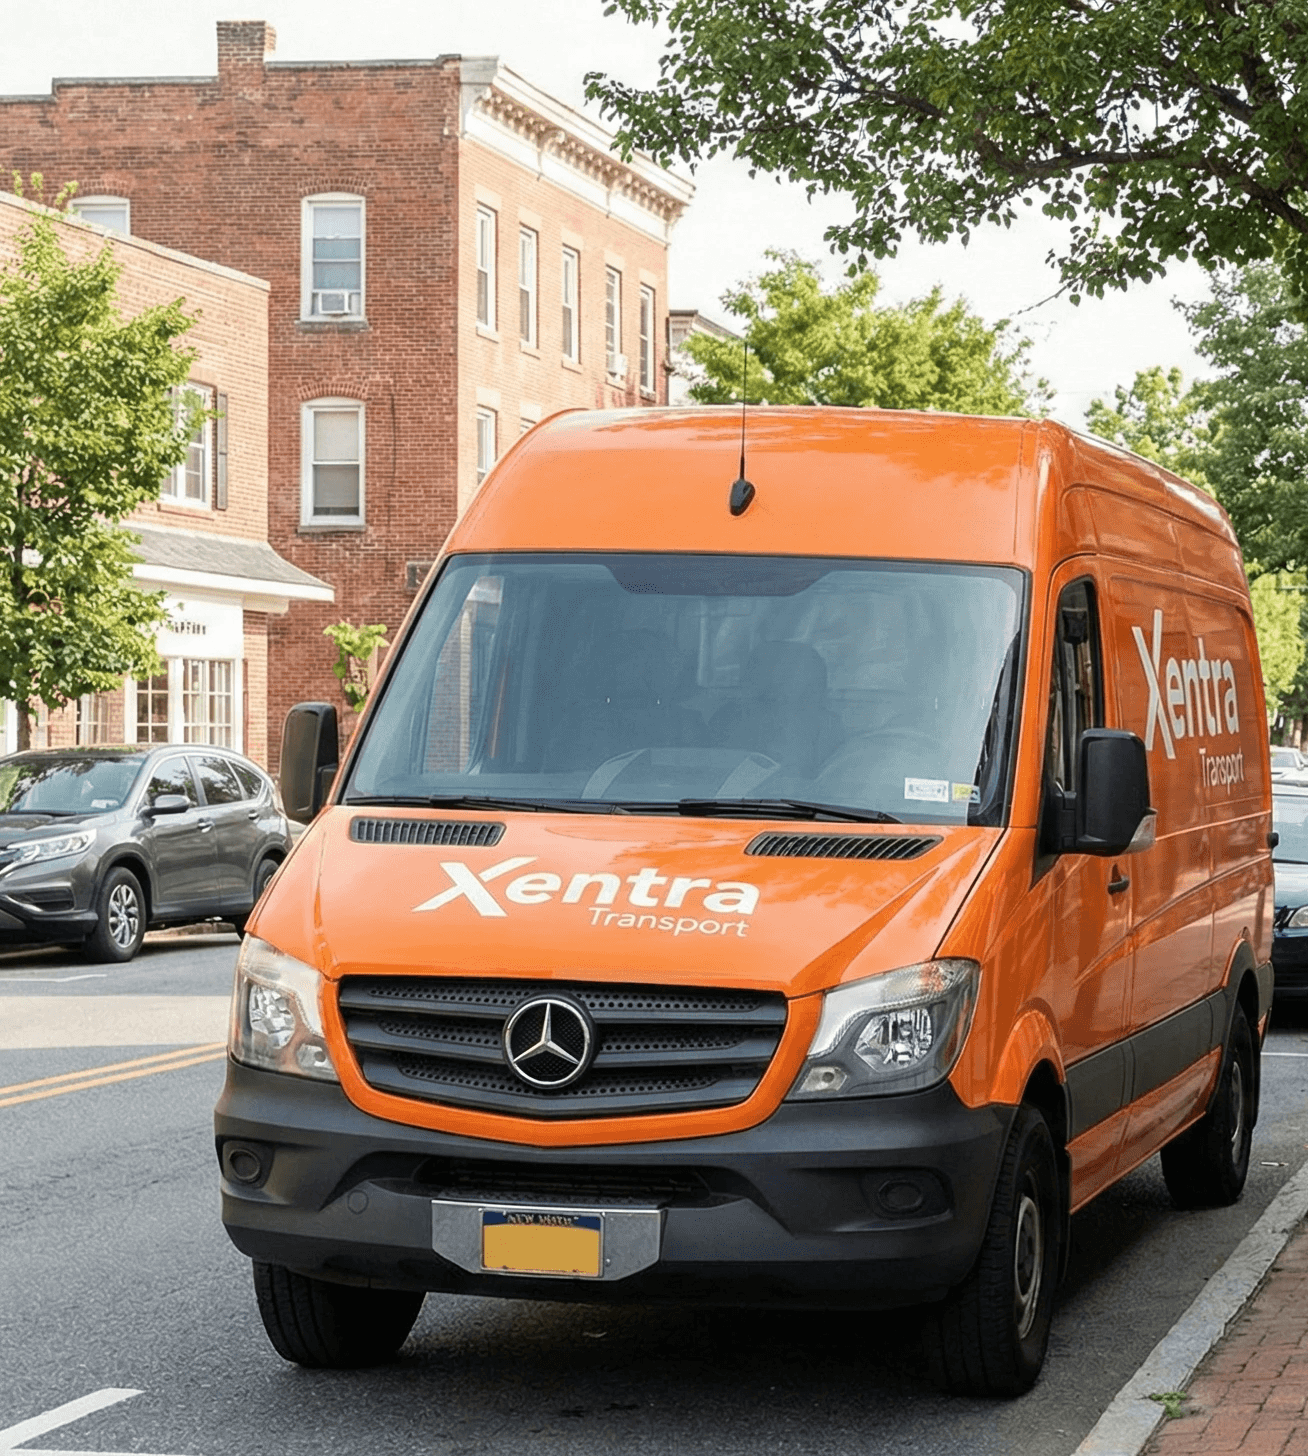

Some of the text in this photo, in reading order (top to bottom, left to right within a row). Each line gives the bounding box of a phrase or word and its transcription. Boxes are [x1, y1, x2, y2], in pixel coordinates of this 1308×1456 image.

[1131, 609, 1239, 759] Xentra
[1199, 746, 1245, 795] Transport
[411, 856, 761, 917] Xentra
[588, 907, 749, 937] Transport
